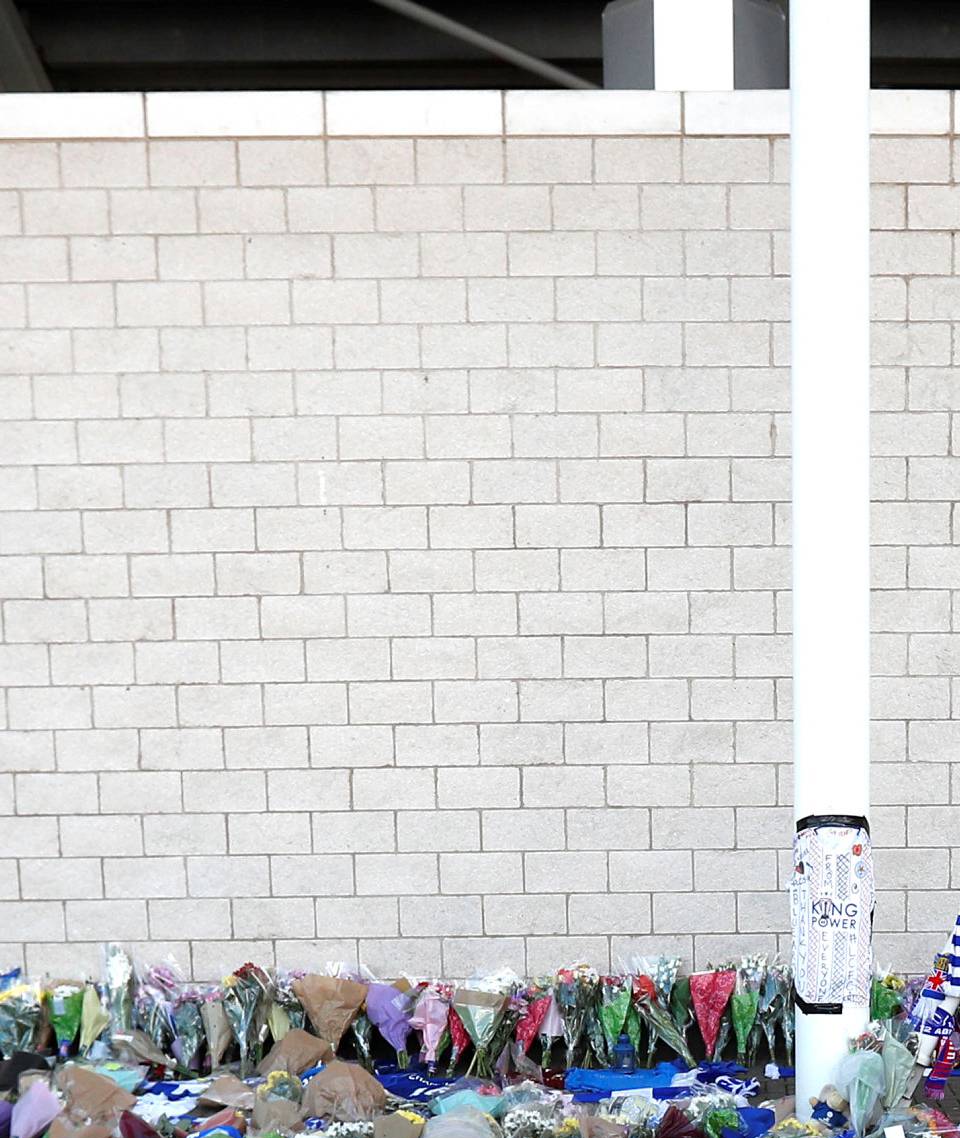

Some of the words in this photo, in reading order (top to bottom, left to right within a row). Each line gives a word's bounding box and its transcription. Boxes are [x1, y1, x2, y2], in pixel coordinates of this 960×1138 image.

[824, 854, 833, 888] FROM
[811, 901, 858, 918] KING
[811, 917, 857, 929] POWER
[817, 931, 830, 1002] EVERYONE
